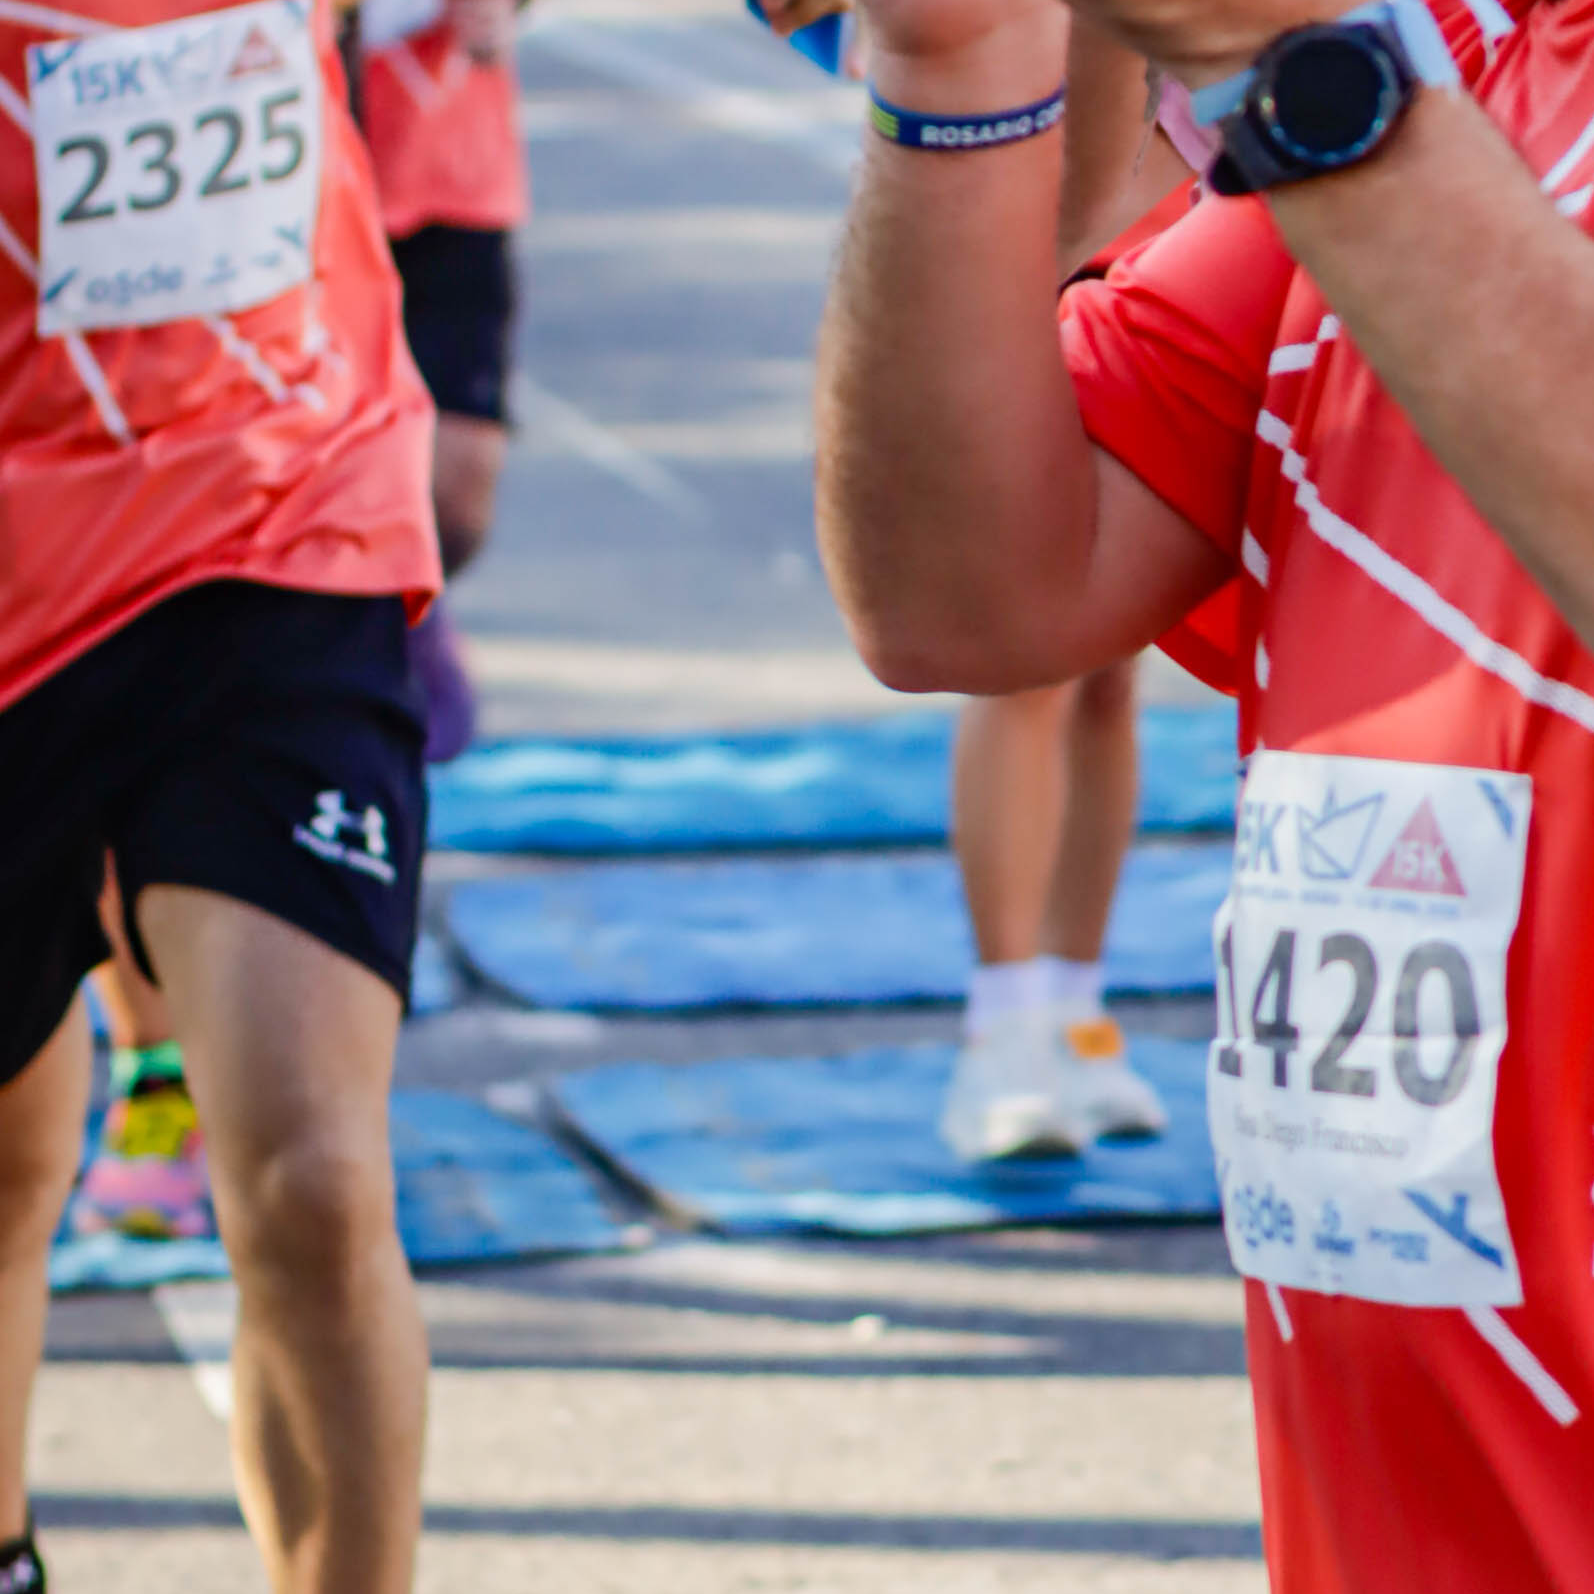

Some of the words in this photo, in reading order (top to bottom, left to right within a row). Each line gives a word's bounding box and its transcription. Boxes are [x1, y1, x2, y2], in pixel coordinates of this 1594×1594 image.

[69, 58, 146, 106] 15K
[55, 91, 305, 226] 2325
[920, 113, 1034, 147] ROSARIO
[1237, 802, 1282, 873] 5K
[1391, 838, 1447, 883] 15K
[1217, 924, 1480, 1107] 1420
